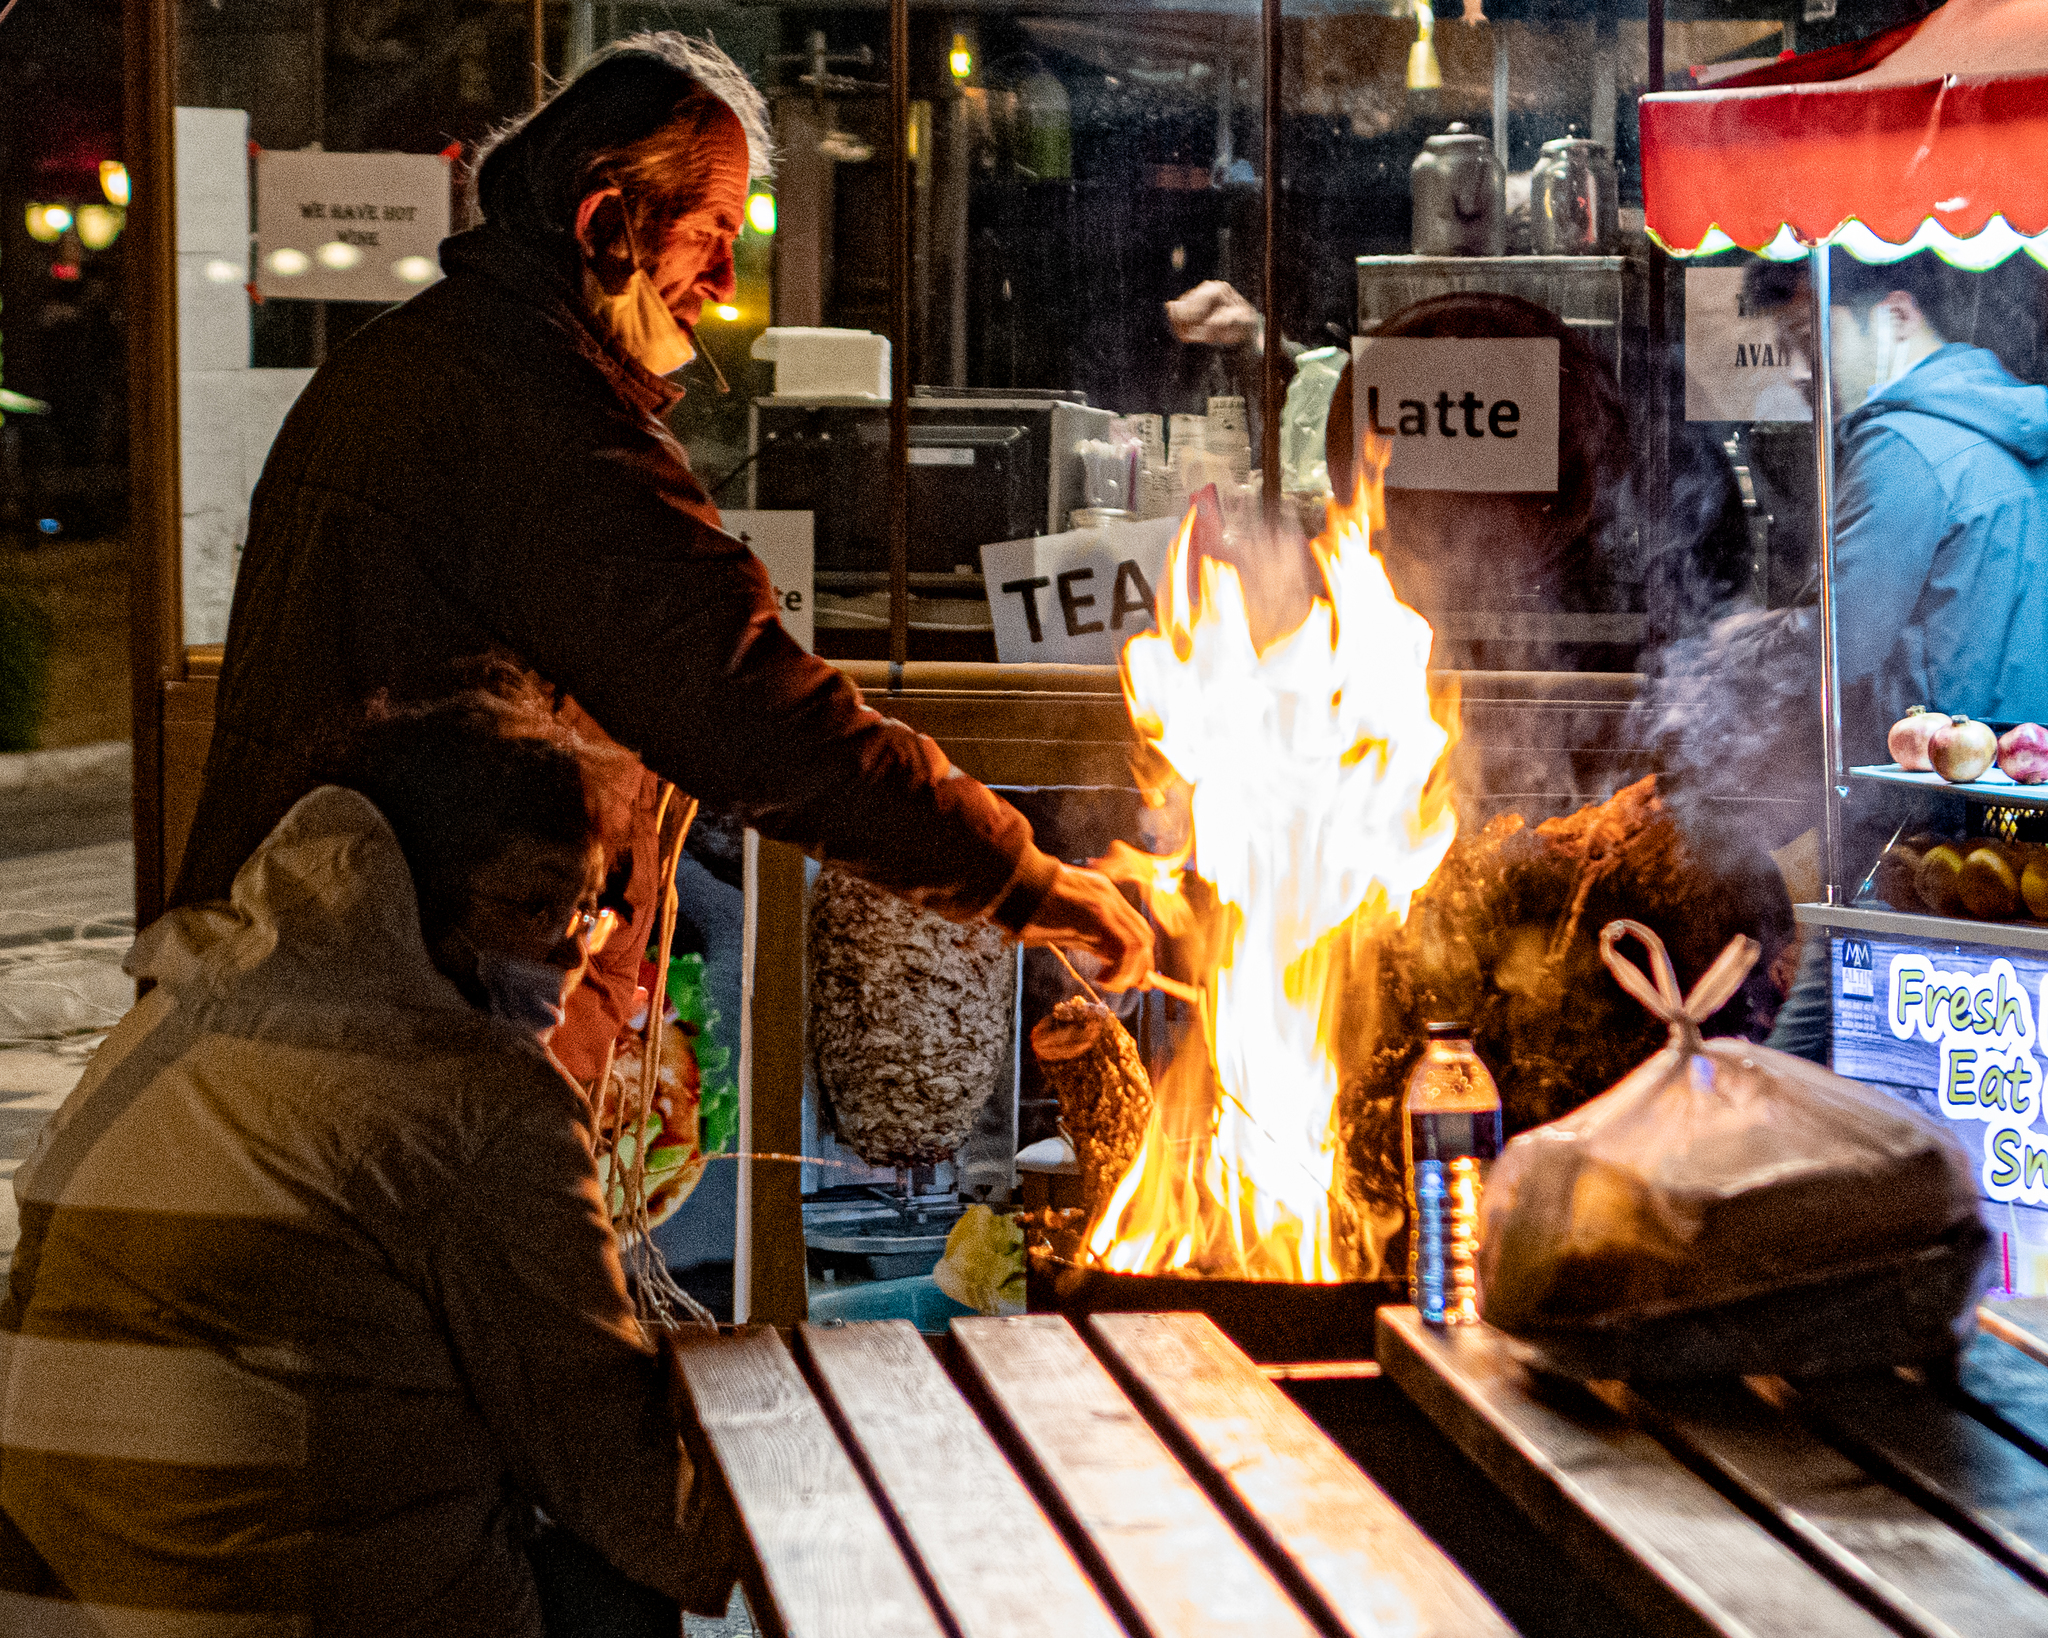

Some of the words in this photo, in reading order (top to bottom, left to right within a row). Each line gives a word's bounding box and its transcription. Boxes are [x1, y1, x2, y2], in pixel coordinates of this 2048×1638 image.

[300, 202, 326, 219] WE
[1367, 386, 1521, 438] Latte
[1001, 559, 1155, 643] TEA
[1897, 968, 2026, 1037] Fresh
[1947, 1049, 2032, 1114] Eat
